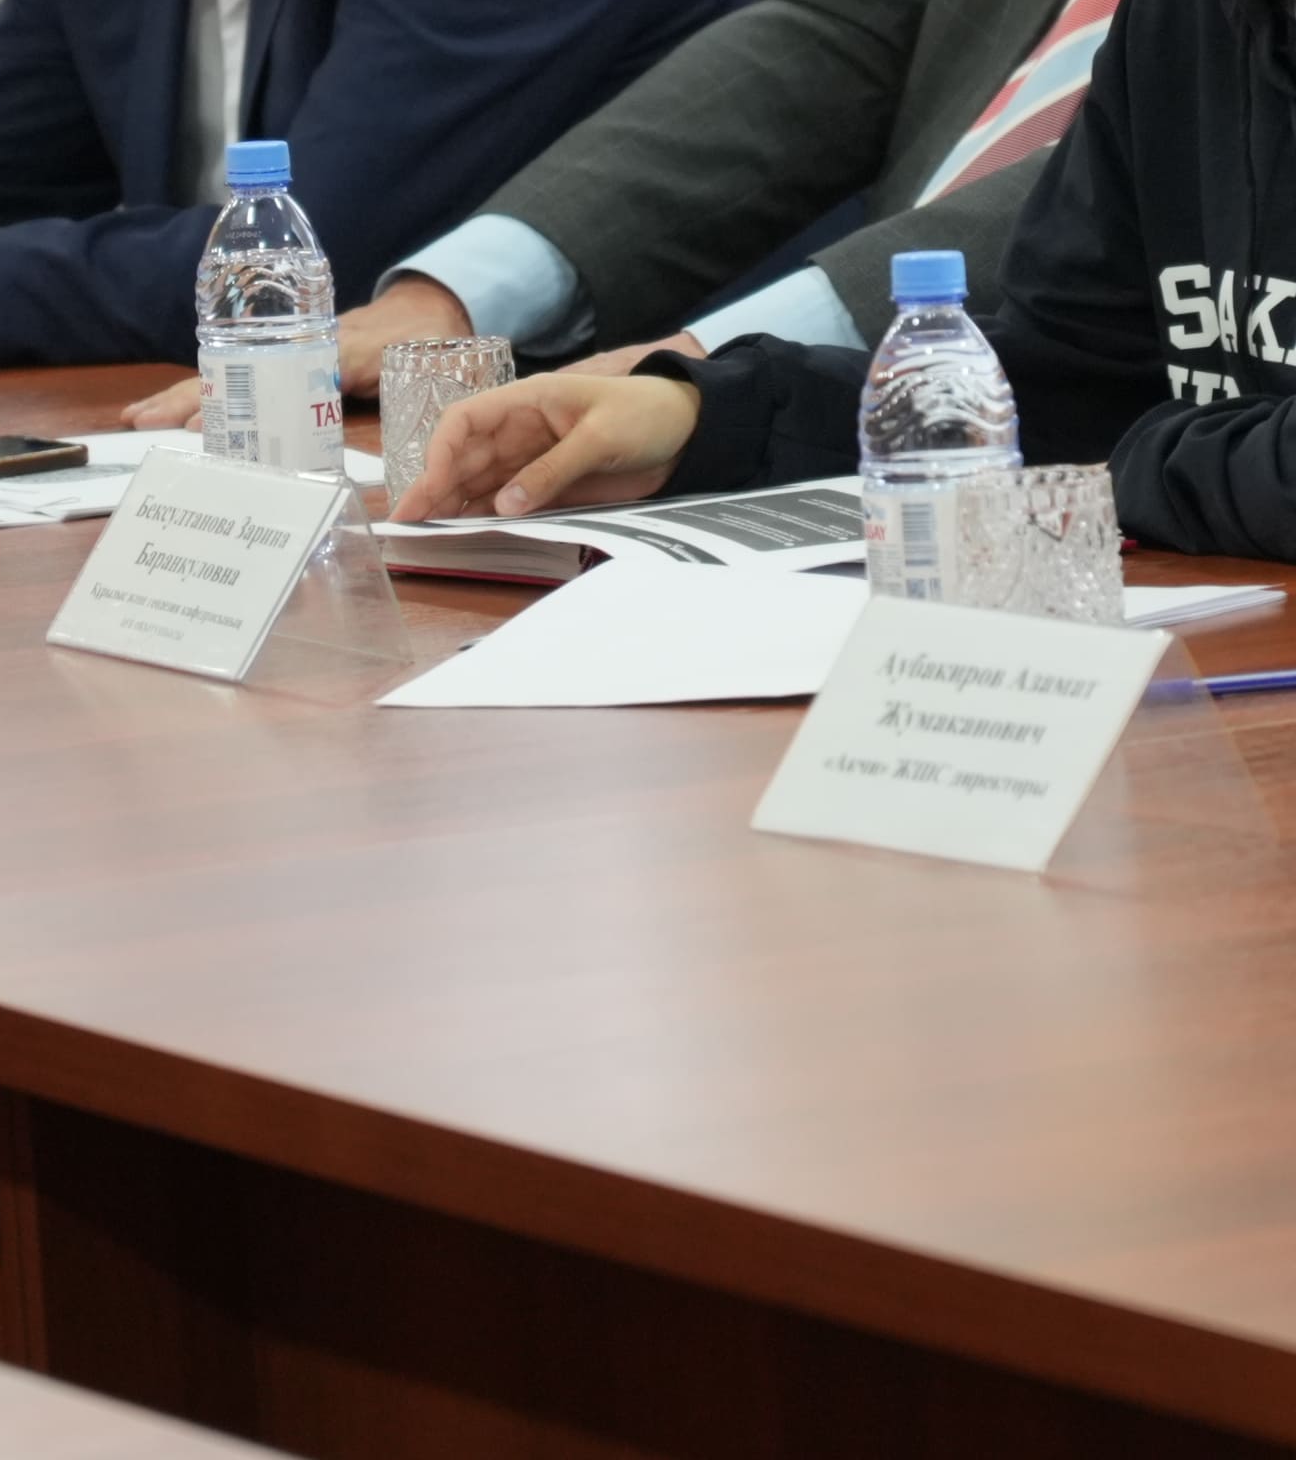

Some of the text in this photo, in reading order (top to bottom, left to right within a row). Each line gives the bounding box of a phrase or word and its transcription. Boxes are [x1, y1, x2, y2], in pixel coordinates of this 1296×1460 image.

[135, 494, 292, 550] Бексултанова Зарина
[133, 541, 242, 587] Баранкуловна
[1008, 666, 1099, 701] Азамат
